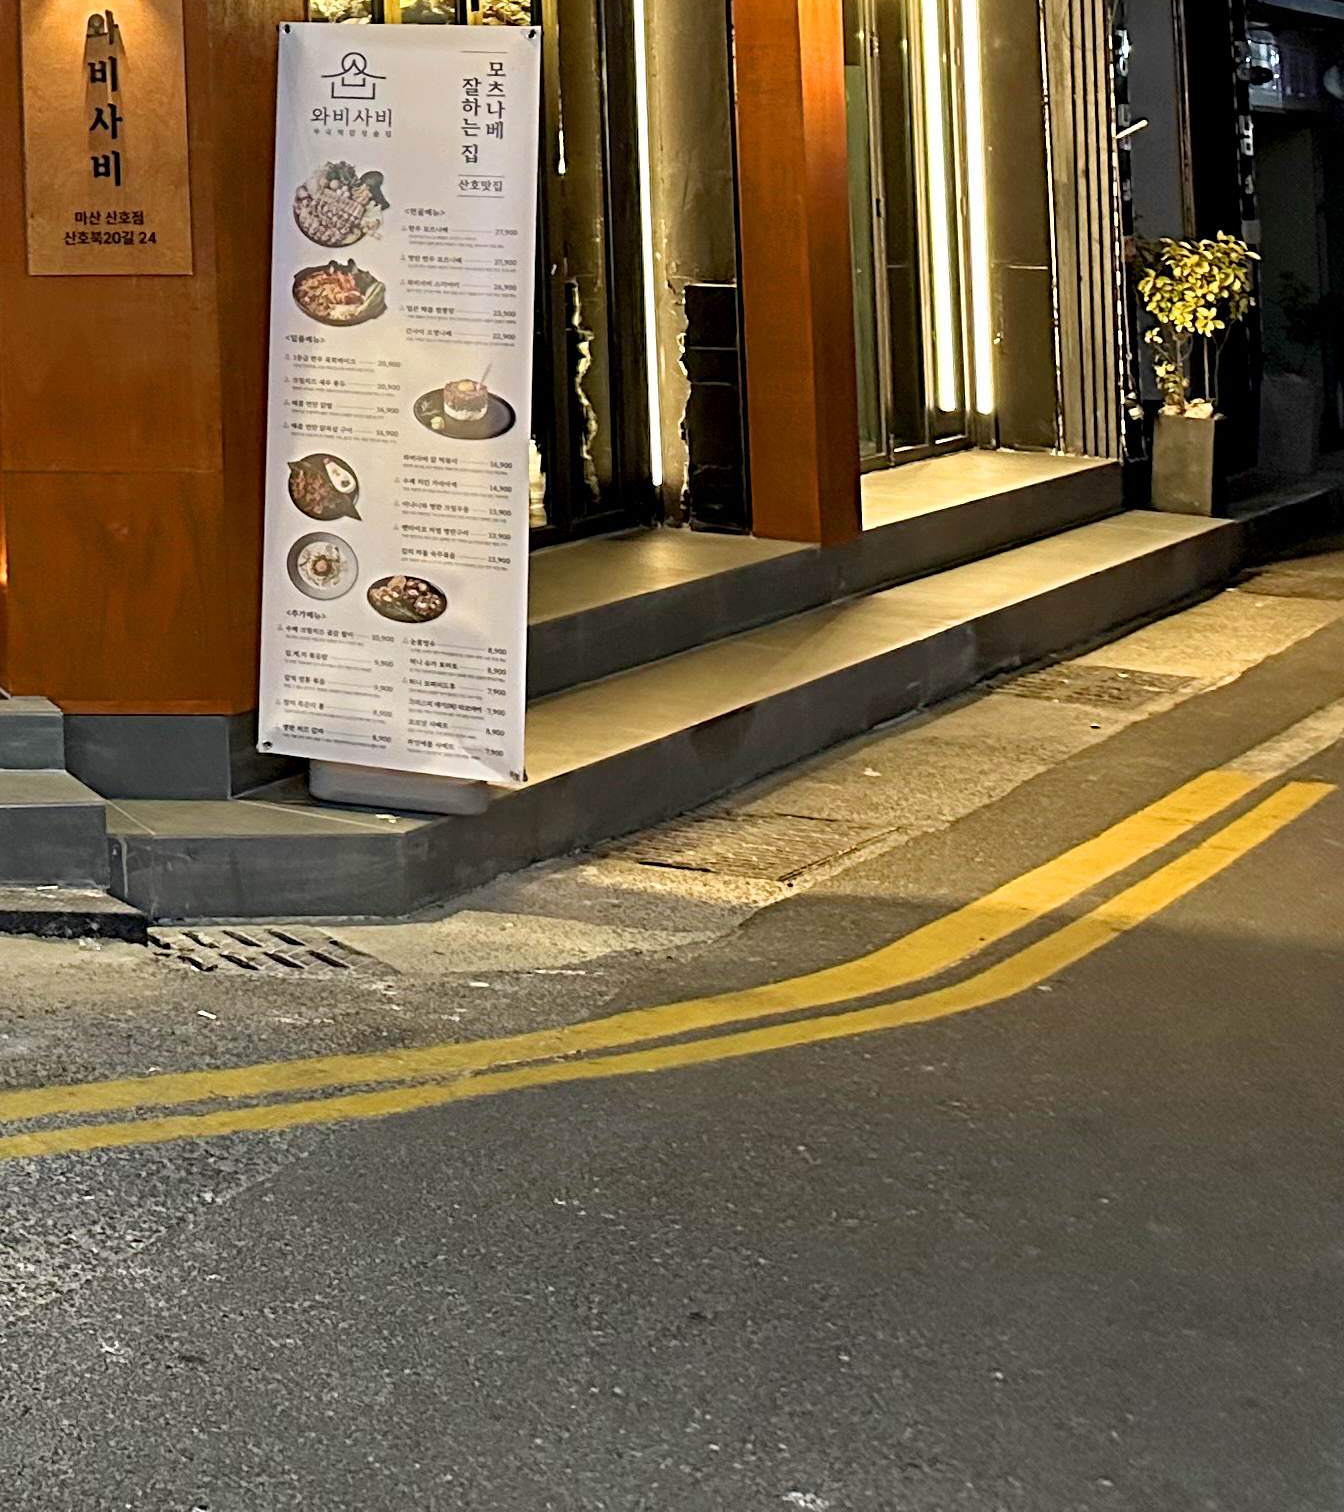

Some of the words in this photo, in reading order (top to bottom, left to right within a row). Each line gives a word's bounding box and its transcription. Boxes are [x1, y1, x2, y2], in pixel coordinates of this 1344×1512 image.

[85, 9, 123, 187] 와비사비
[461, 78, 482, 138] 잘하는
[486, 61, 506, 140] 모츠나베
[311, 107, 393, 128] 와비사비
[461, 144, 479, 164] 집
[458, 179, 503, 192] 산호맛집
[74, 210, 101, 226] 마산
[105, 210, 144, 226] 산호점
[138, 231, 157, 245] 24
